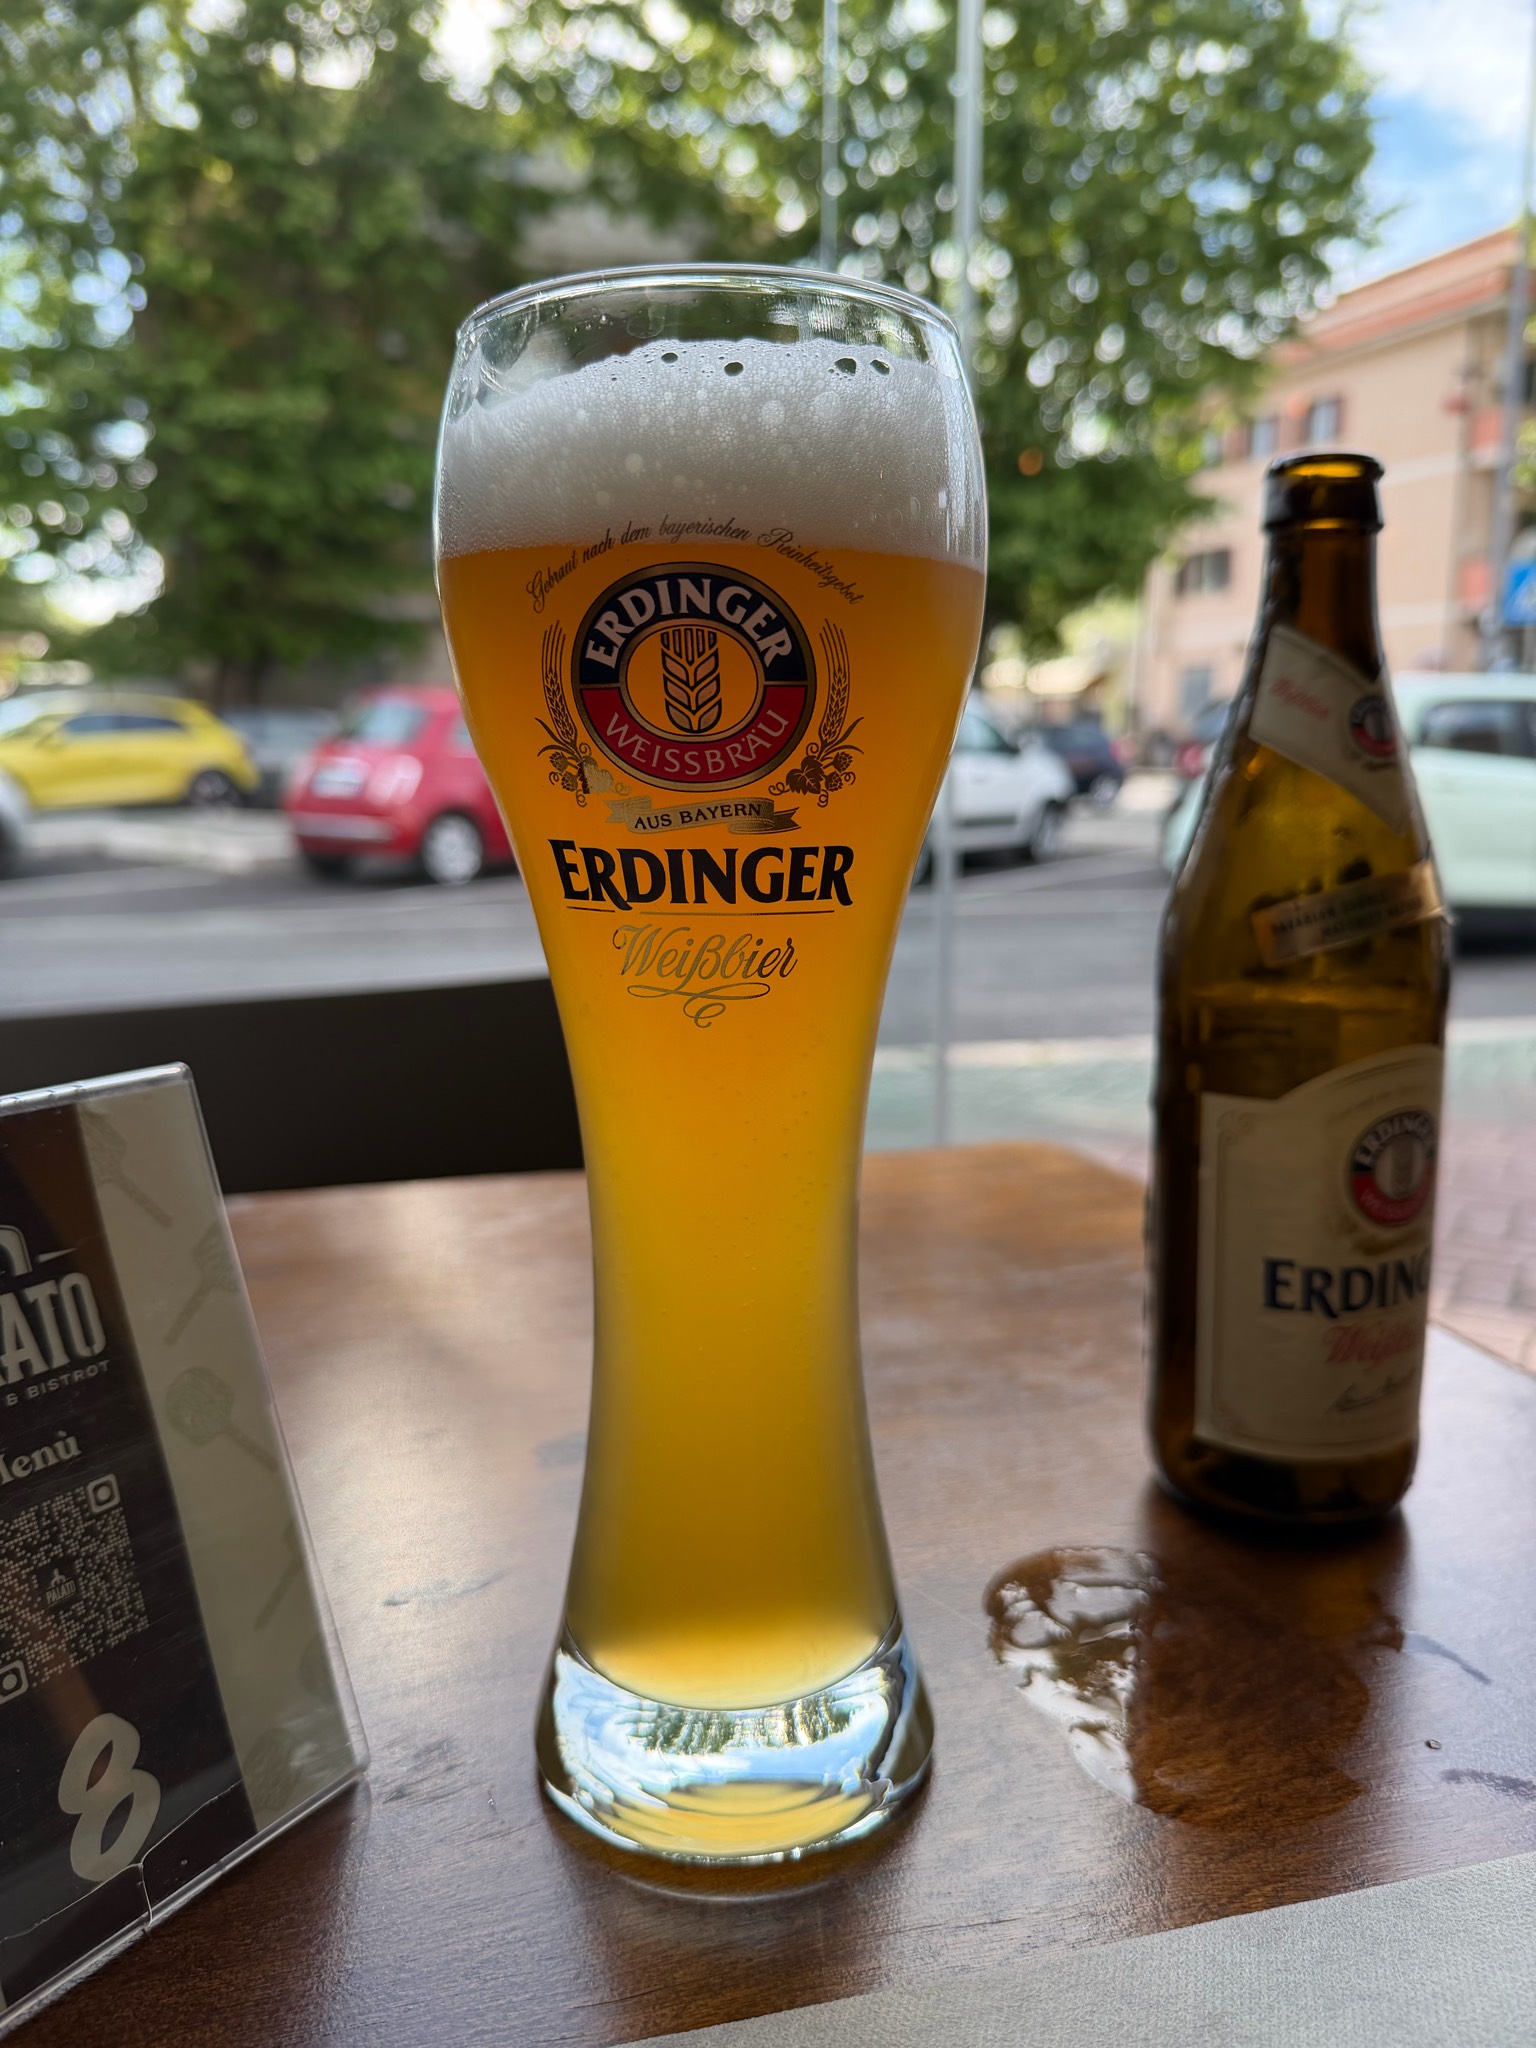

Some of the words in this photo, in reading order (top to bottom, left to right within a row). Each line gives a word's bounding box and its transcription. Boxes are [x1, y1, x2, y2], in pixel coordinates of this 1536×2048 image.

[526, 549, 578, 613] Gebraut
[582, 528, 615, 563] nach
[620, 520, 653, 545] dem
[658, 514, 752, 544] bayerischen
[757, 527, 865, 606] Reinheitsgebot
[584, 577, 794, 670] ERDINGER
[605, 708, 790, 776] WEISSBRÄU
[633, 812, 673, 832] AUS
[680, 802, 762, 824] BAYERN
[547, 838, 855, 911] ERDINGER
[612, 923, 798, 994] Weißbier
[0, 1271, 107, 1386] ATO
[26, 1359, 111, 1399] BISTROT
[58, 1712, 161, 1883] 8
